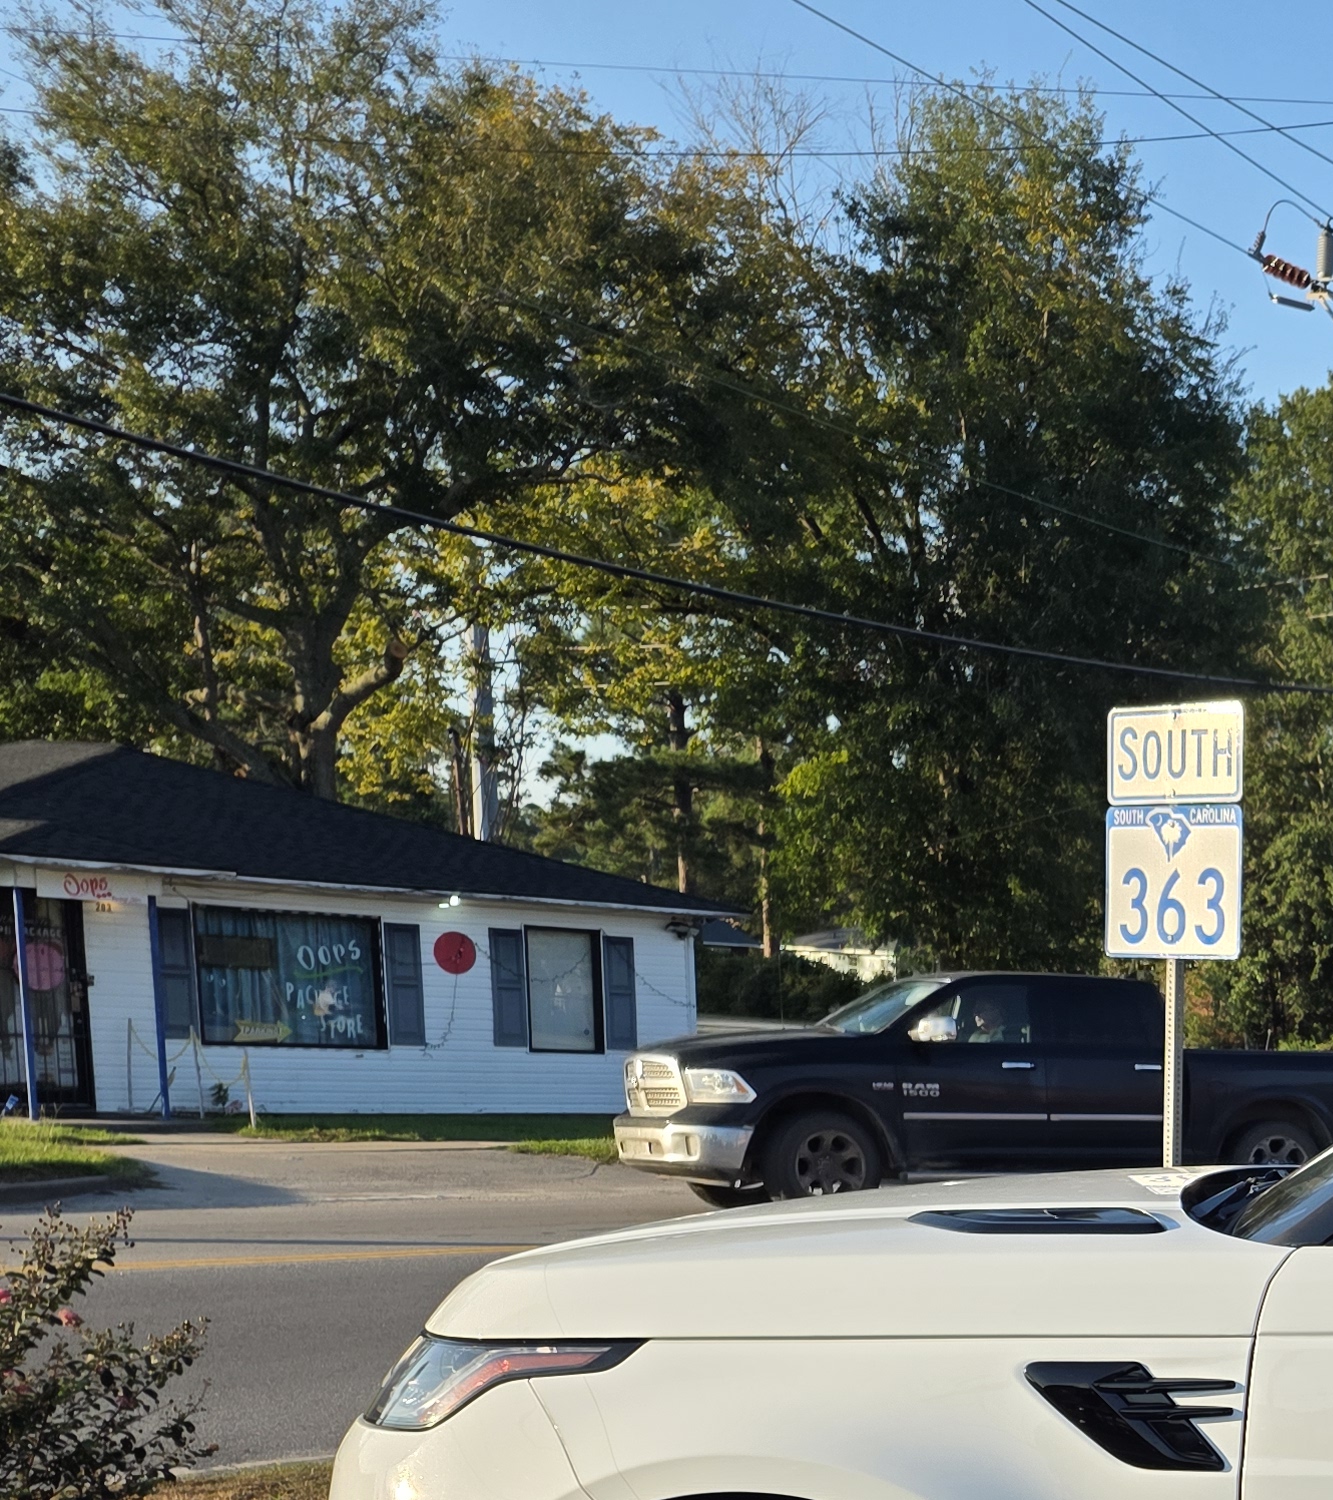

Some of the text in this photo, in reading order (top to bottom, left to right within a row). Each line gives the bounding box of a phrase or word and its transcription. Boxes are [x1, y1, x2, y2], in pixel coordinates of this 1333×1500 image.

[1117, 726, 1233, 781] SOUTH
[1113, 807, 1237, 825] SOUTH CAROLINA
[1119, 867, 1225, 945] 363
[285, 981, 349, 1010] PACKGE
[320, 1014, 363, 1039] STORE
[902, 1089, 940, 1097] 1500
